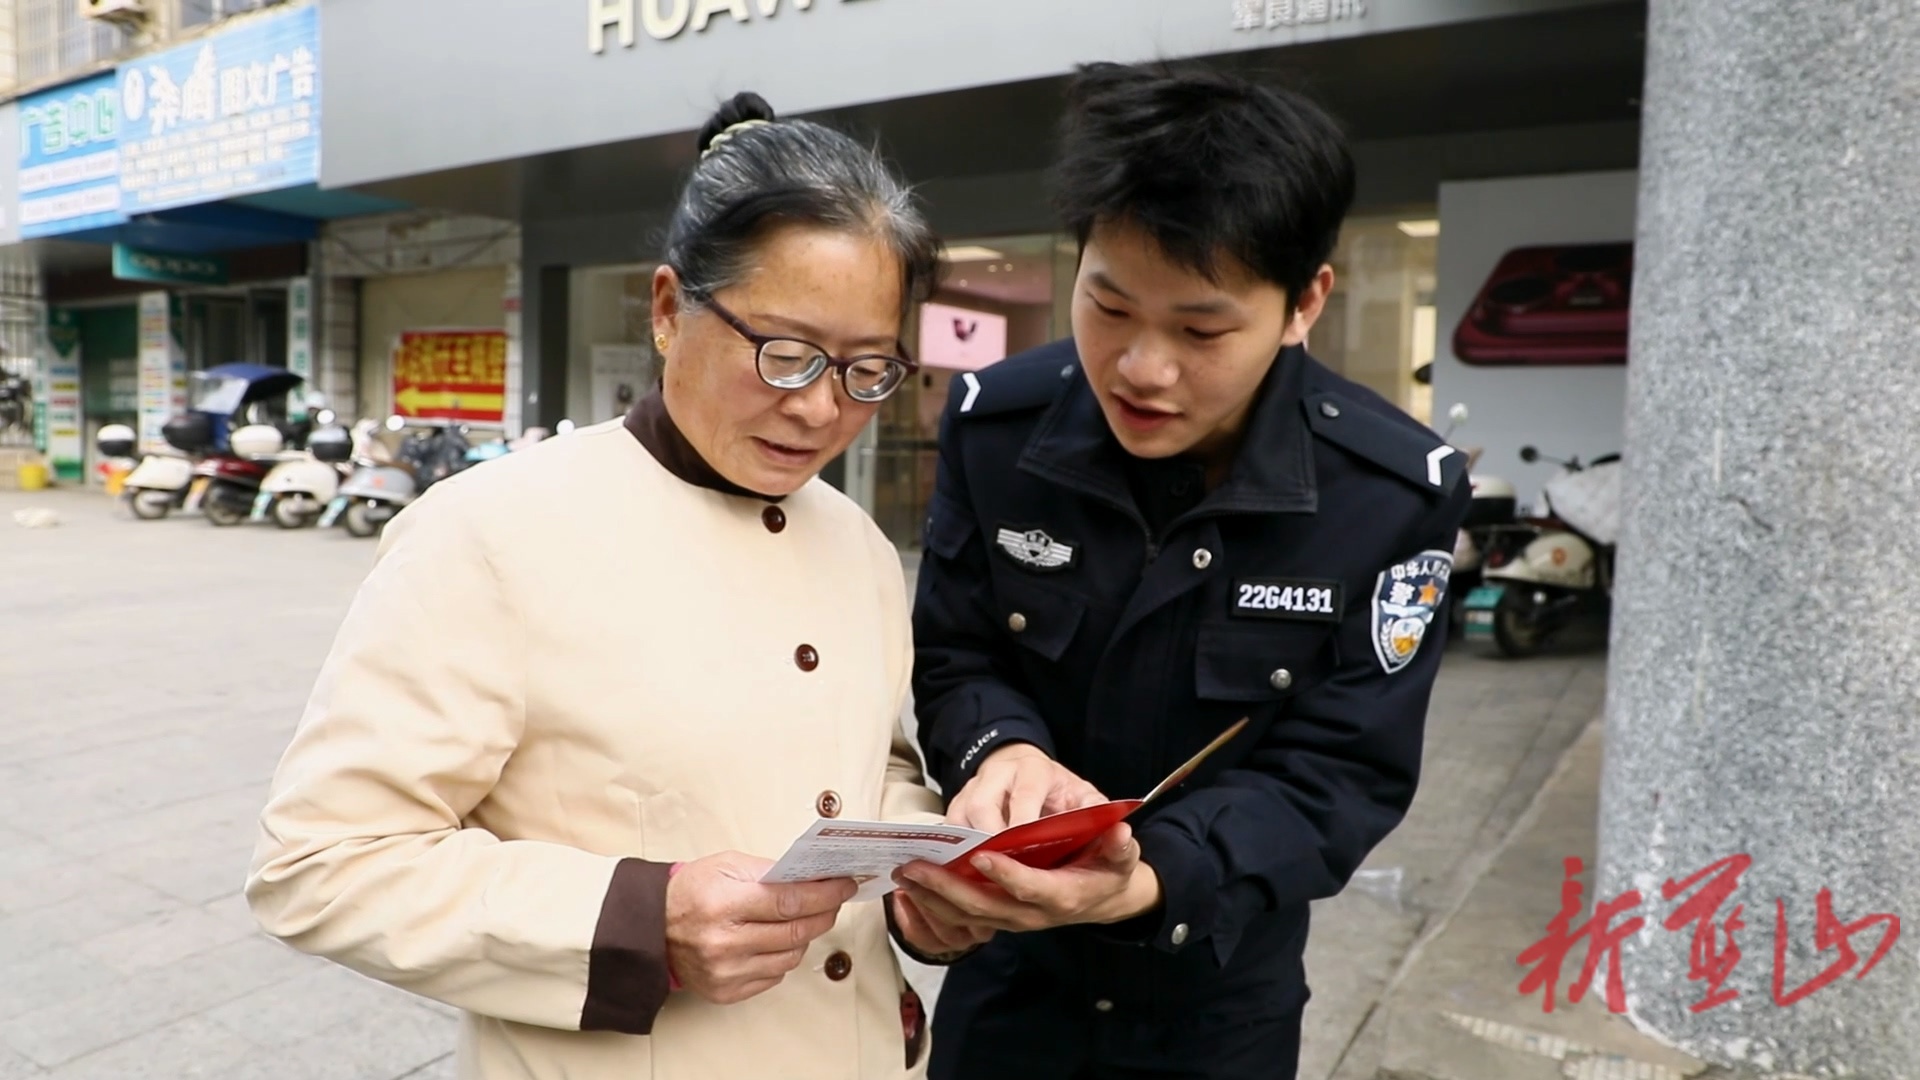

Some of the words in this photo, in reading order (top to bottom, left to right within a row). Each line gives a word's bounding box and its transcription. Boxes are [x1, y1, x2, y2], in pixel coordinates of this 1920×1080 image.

[588, 0, 880, 54] HUA
[1238, 584, 1334, 613] 22G4131
[960, 728, 999, 770] POLICE
